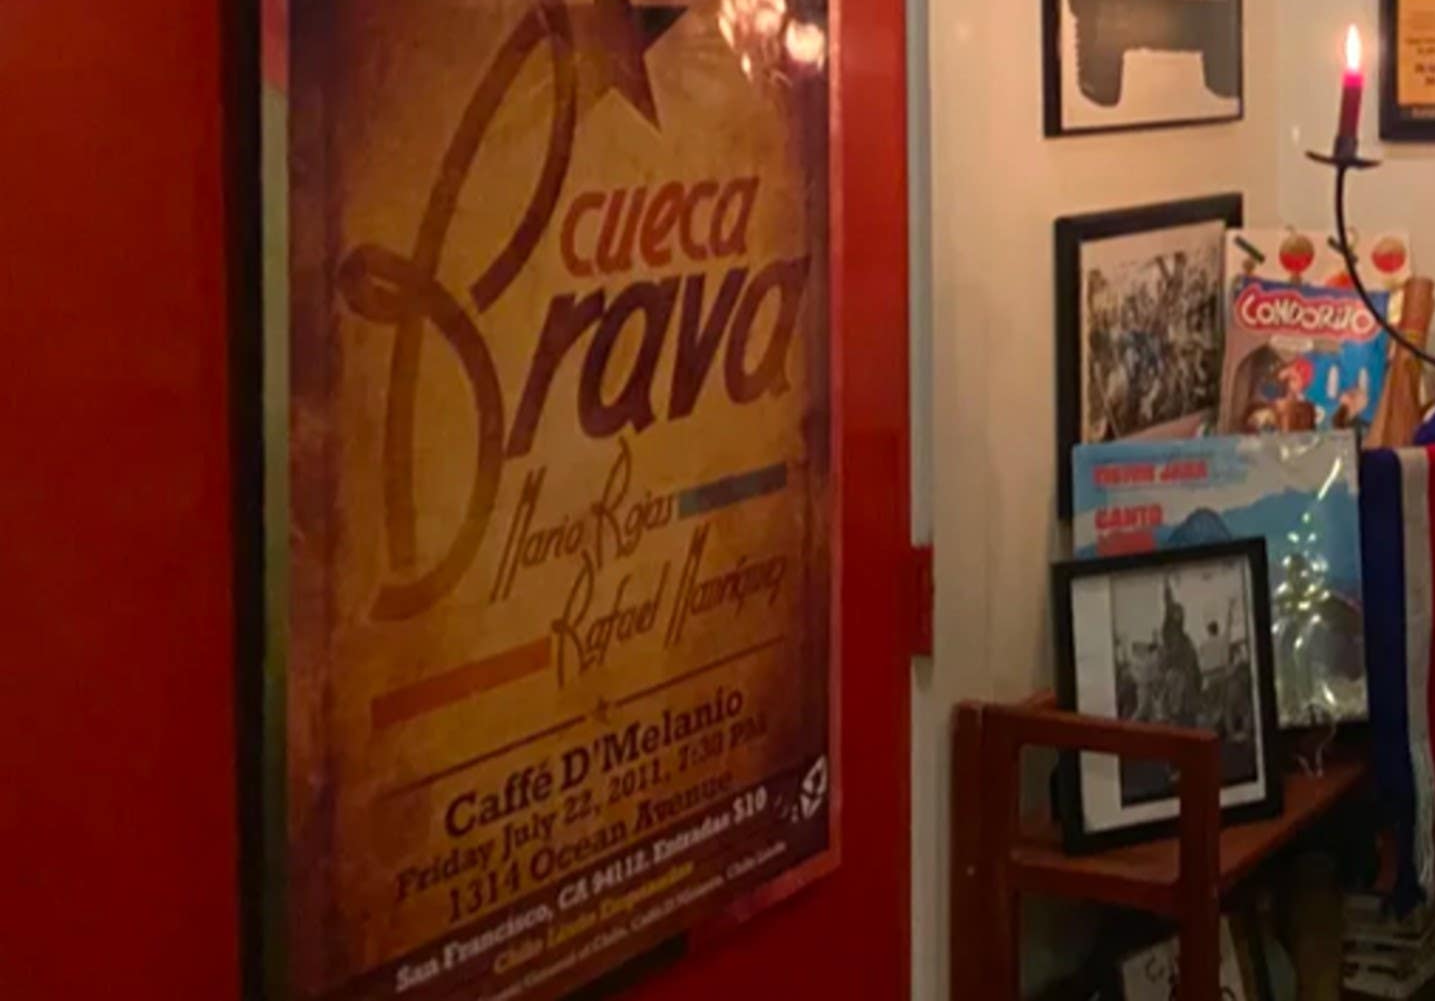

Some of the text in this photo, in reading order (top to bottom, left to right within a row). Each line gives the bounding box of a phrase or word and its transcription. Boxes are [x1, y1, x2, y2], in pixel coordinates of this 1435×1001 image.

[559, 176, 761, 278] cueca
[445, 685, 743, 838] Caffé D'Melanio
[396, 838, 496, 902] Friday
[502, 810, 557, 862] July
[449, 770, 734, 925] 1314 Ocean Avenue
[395, 957, 440, 993] San
[557, 877, 589, 910] CA
